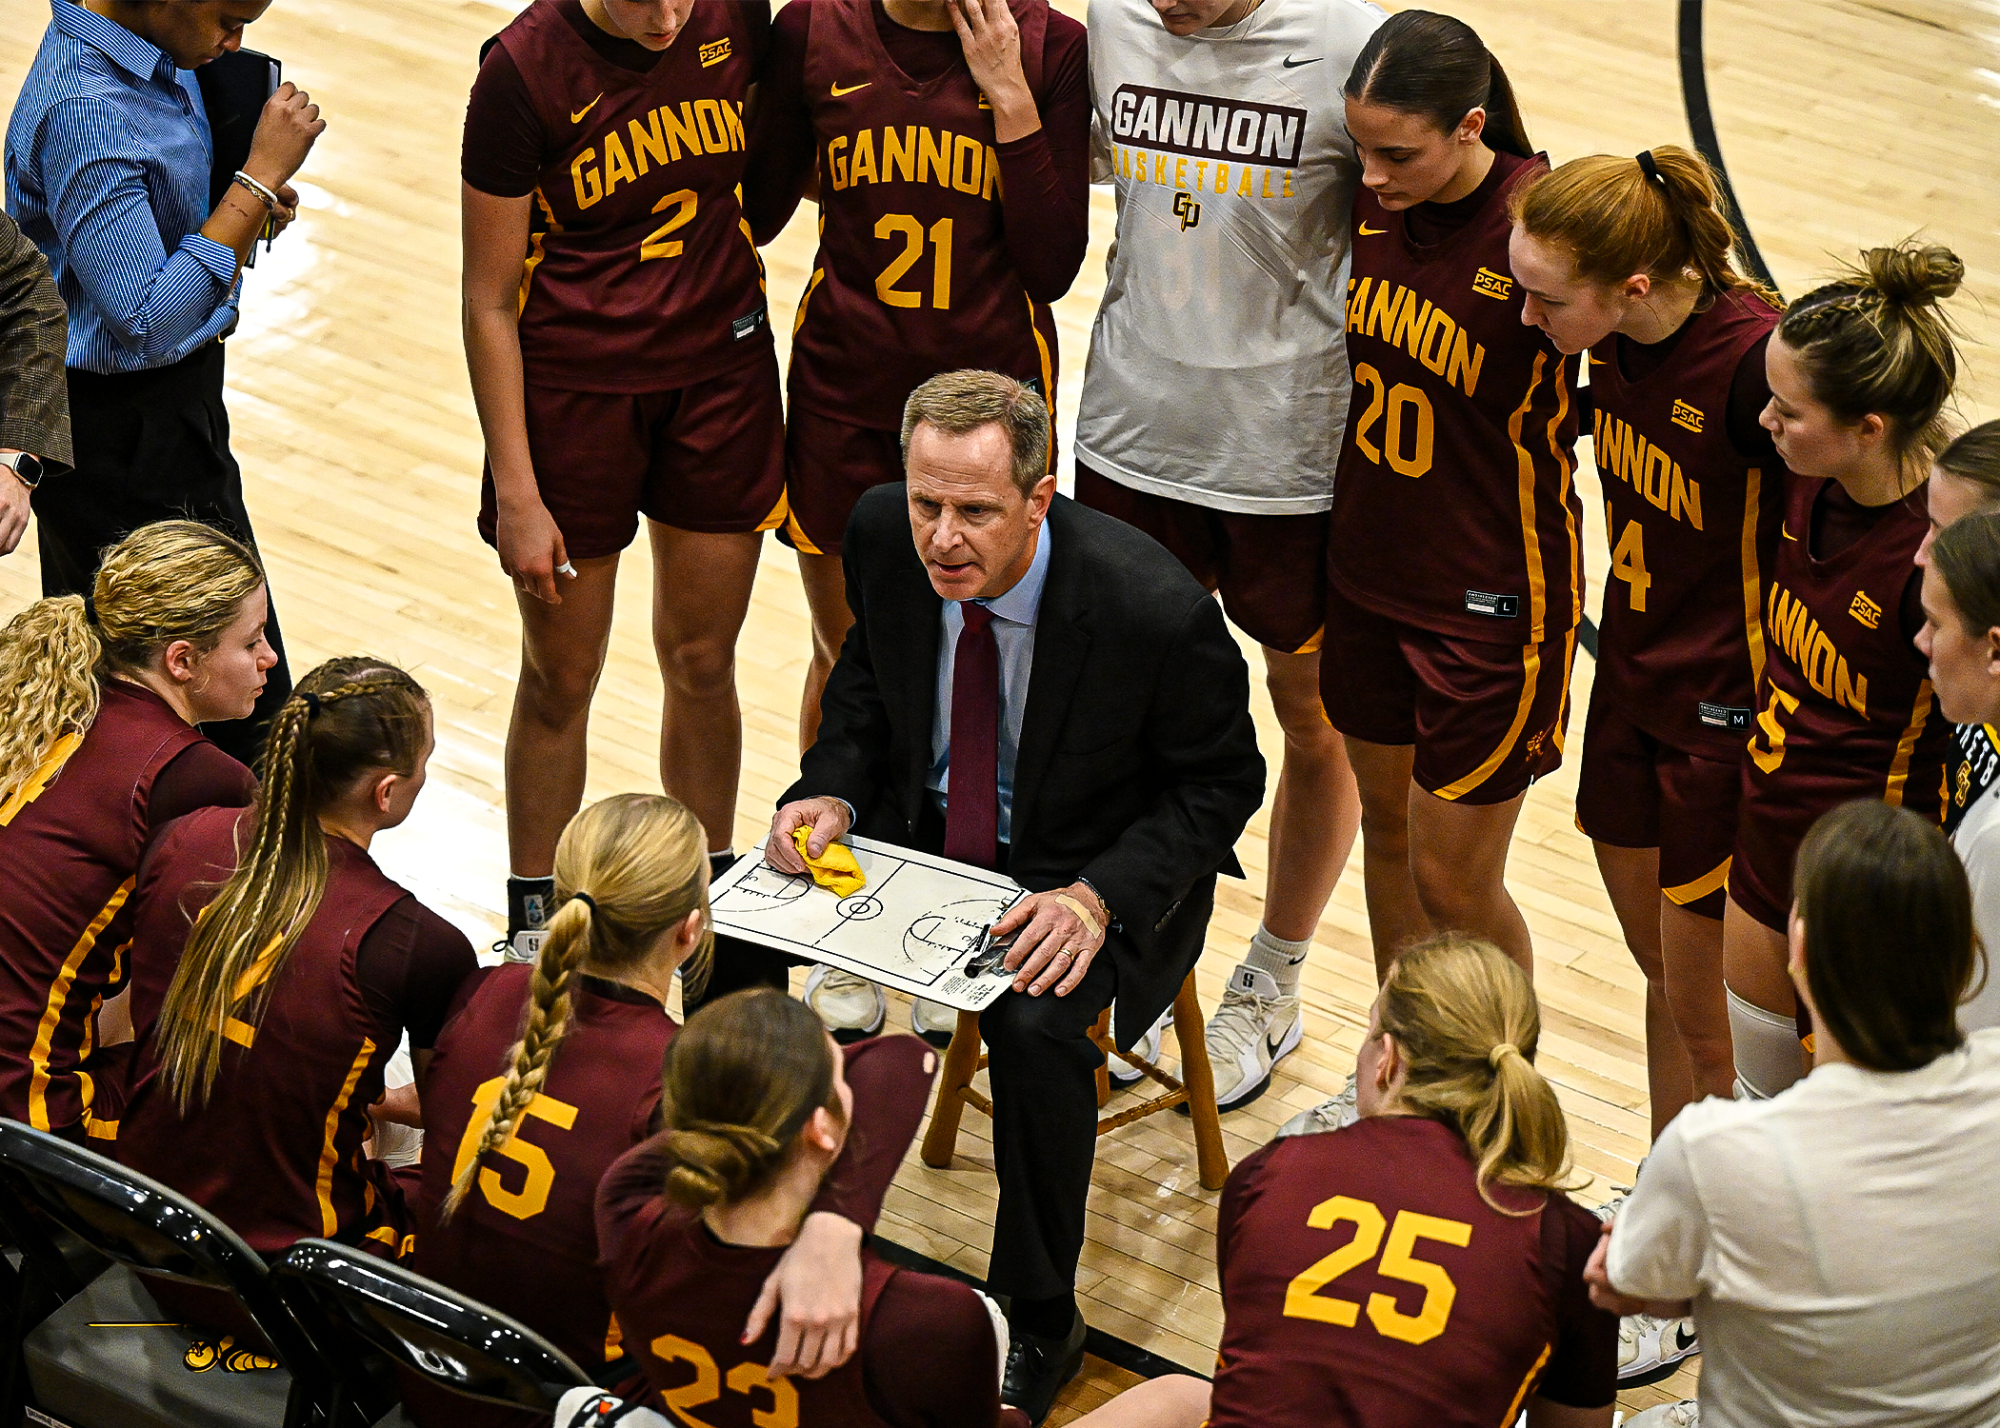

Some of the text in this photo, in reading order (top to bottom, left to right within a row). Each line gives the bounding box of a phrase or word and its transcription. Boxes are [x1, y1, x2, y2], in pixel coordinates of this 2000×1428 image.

[700, 41, 732, 62] PSAC
[571, 99, 745, 210] GANNON
[1114, 91, 1299, 160] GANNON
[828, 126, 1003, 201] GANNON
[640, 188, 698, 262] 2
[874, 213, 953, 310] 21
[1474, 273, 1513, 296] PSAC
[1355, 361, 1434, 478] 20
[1672, 404, 1704, 429] PSAC
[1503, 602, 1511, 611] L
[1850, 596, 1882, 626] PSAC
[1733, 715, 1744, 725] M
[451, 1076, 579, 1220] 15
[1283, 1195, 1473, 1345] 25
